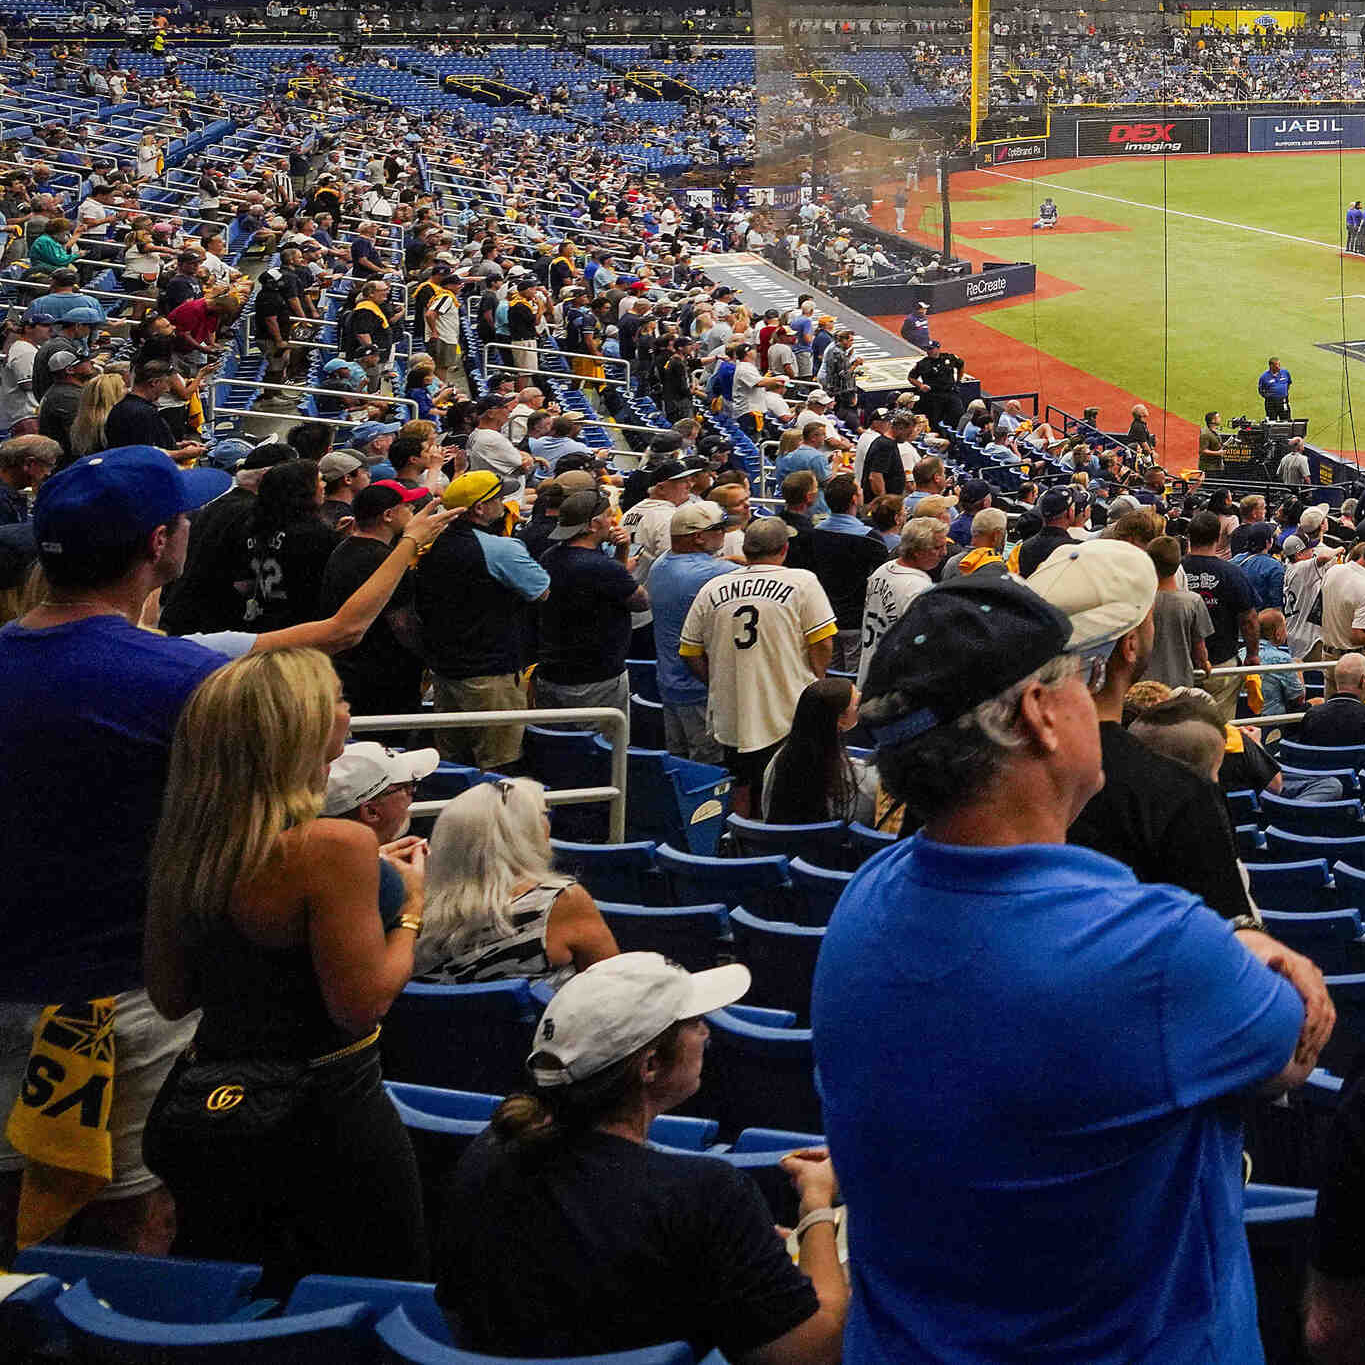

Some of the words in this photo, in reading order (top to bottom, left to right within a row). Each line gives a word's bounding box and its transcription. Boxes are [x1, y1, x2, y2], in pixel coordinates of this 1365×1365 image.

[1108, 123, 1176, 142] DEX
[1275, 119, 1344, 133] JABIL
[1124, 142, 1182, 153] imaging
[967, 277, 1007, 297] ReCreate
[709, 578, 794, 610] LONGORIA
[732, 604, 760, 650] 3
